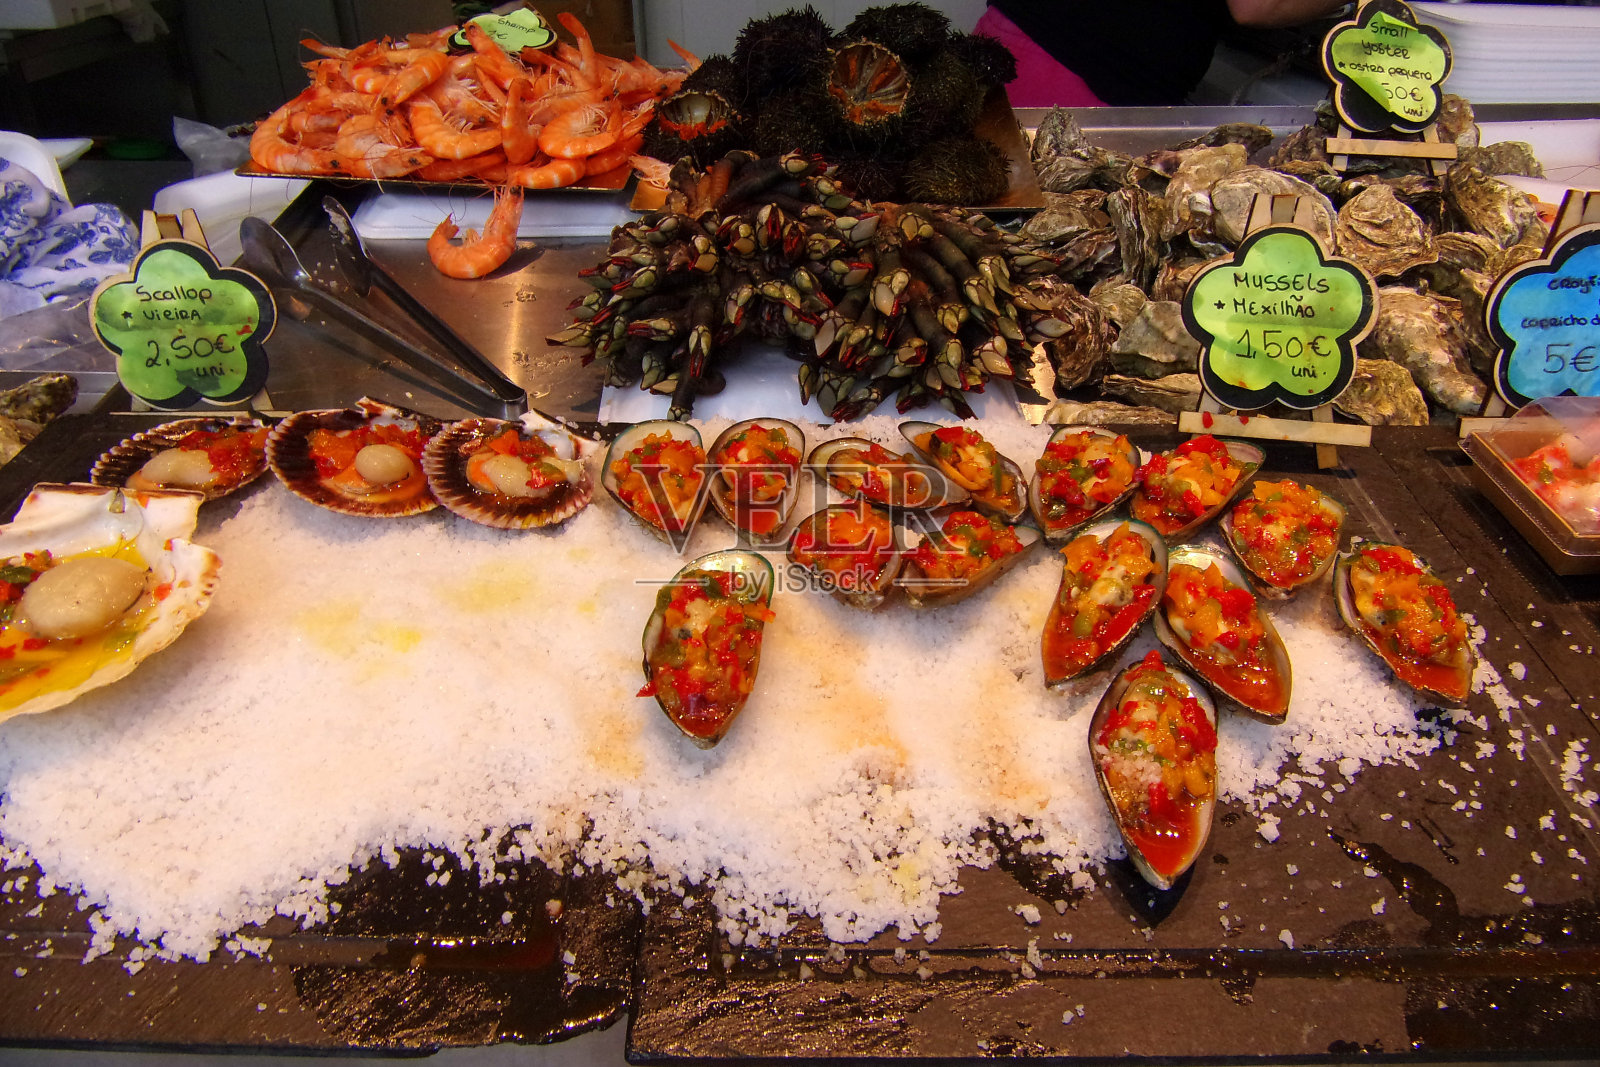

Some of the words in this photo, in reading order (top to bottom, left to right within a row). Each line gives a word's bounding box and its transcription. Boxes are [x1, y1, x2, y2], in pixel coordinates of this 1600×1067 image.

[1370, 21, 1408, 38] Small
[136, 285, 213, 304] Scallop
[145, 333, 235, 368] 2,50€
[1543, 342, 1600, 374] 5€
